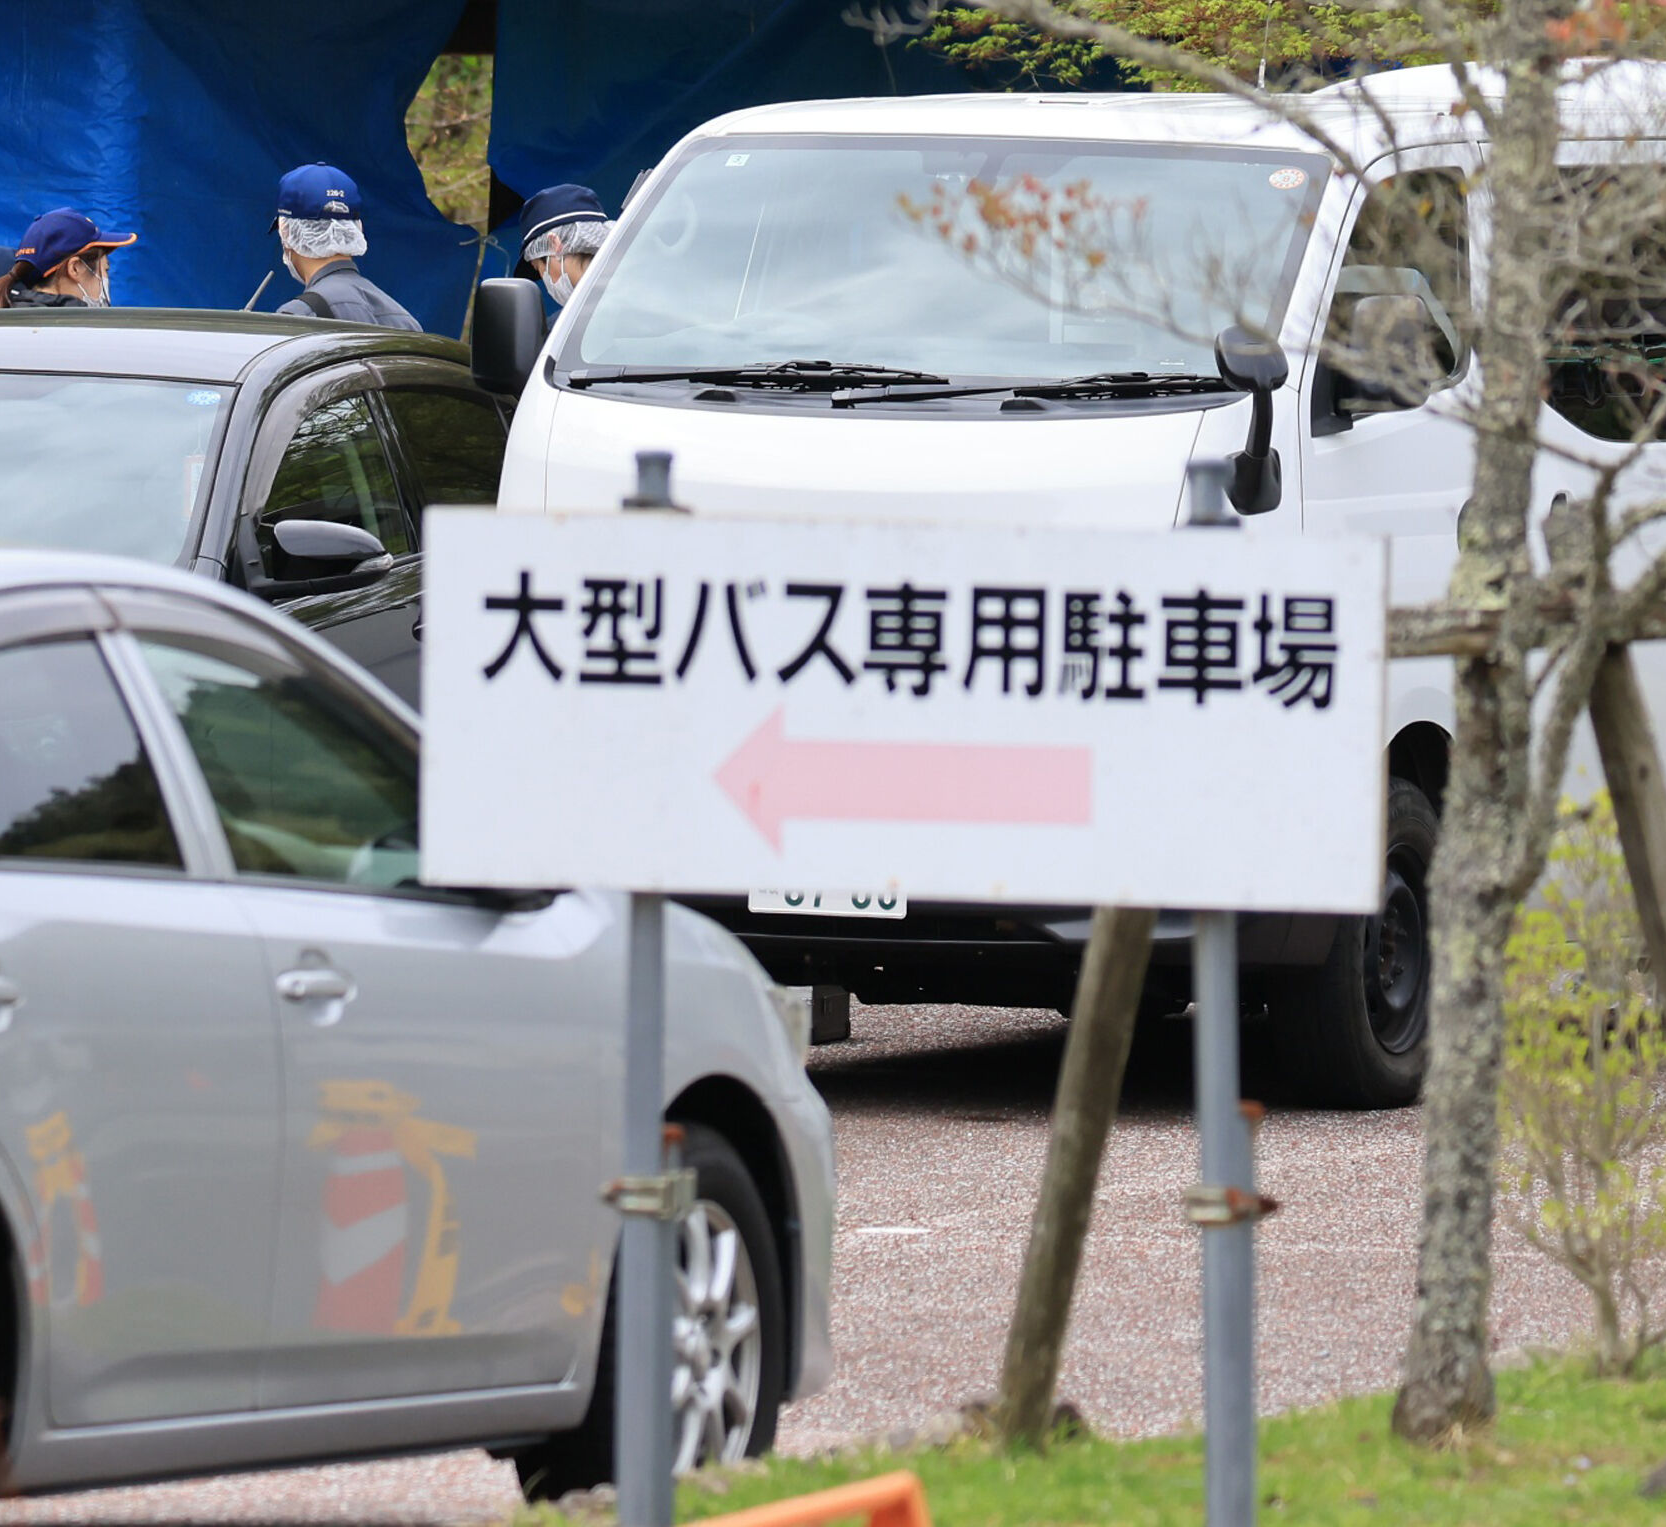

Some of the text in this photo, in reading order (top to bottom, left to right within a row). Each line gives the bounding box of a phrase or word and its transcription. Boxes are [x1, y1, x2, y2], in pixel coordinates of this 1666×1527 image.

[482, 569, 1339, 710] 大型バス専用駐車場
